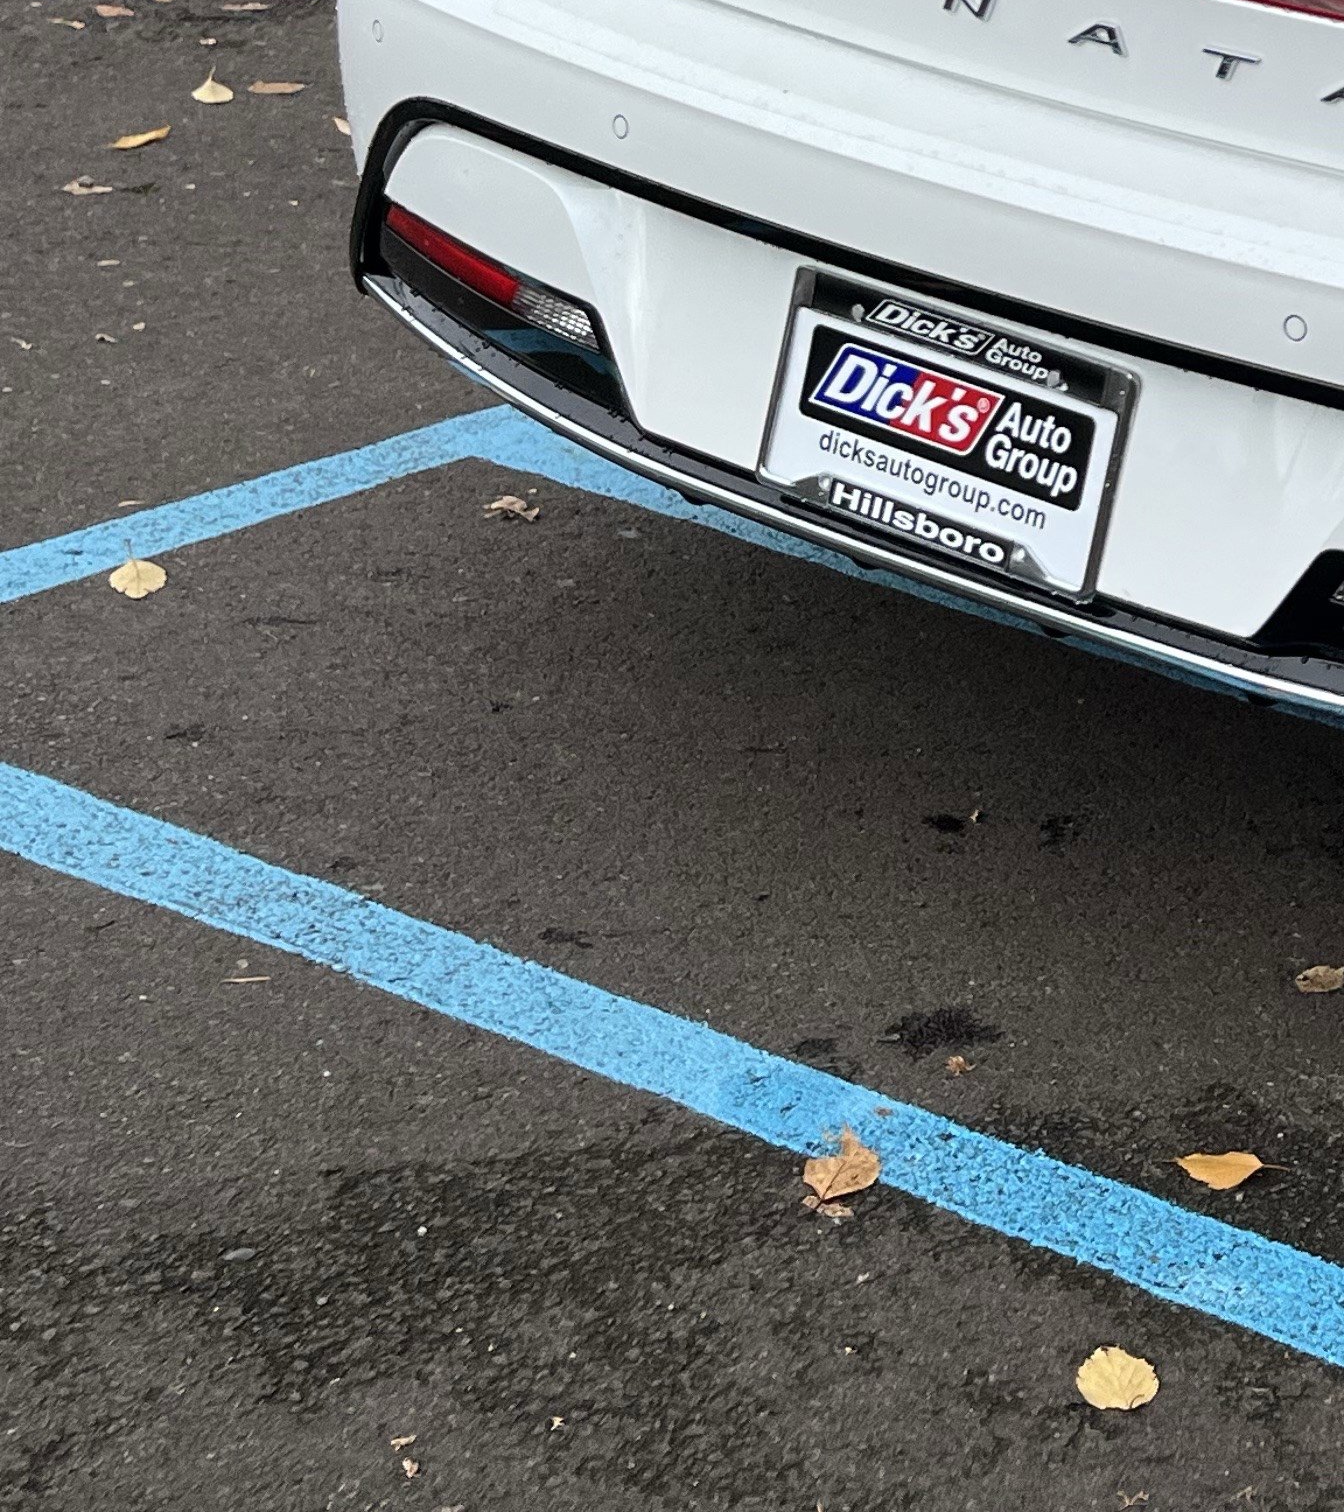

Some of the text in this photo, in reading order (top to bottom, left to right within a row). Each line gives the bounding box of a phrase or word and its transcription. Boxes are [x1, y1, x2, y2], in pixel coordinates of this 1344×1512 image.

[875, 303, 981, 351] Dick's
[993, 338, 1043, 364] Auto
[985, 348, 1051, 381] Group
[823, 353, 979, 445] Dick's
[995, 402, 1072, 454] Auto
[819, 430, 1047, 530] dicksautogroup.com
[984, 438, 1079, 499] Group
[831, 481, 1006, 564] Hillsboro
